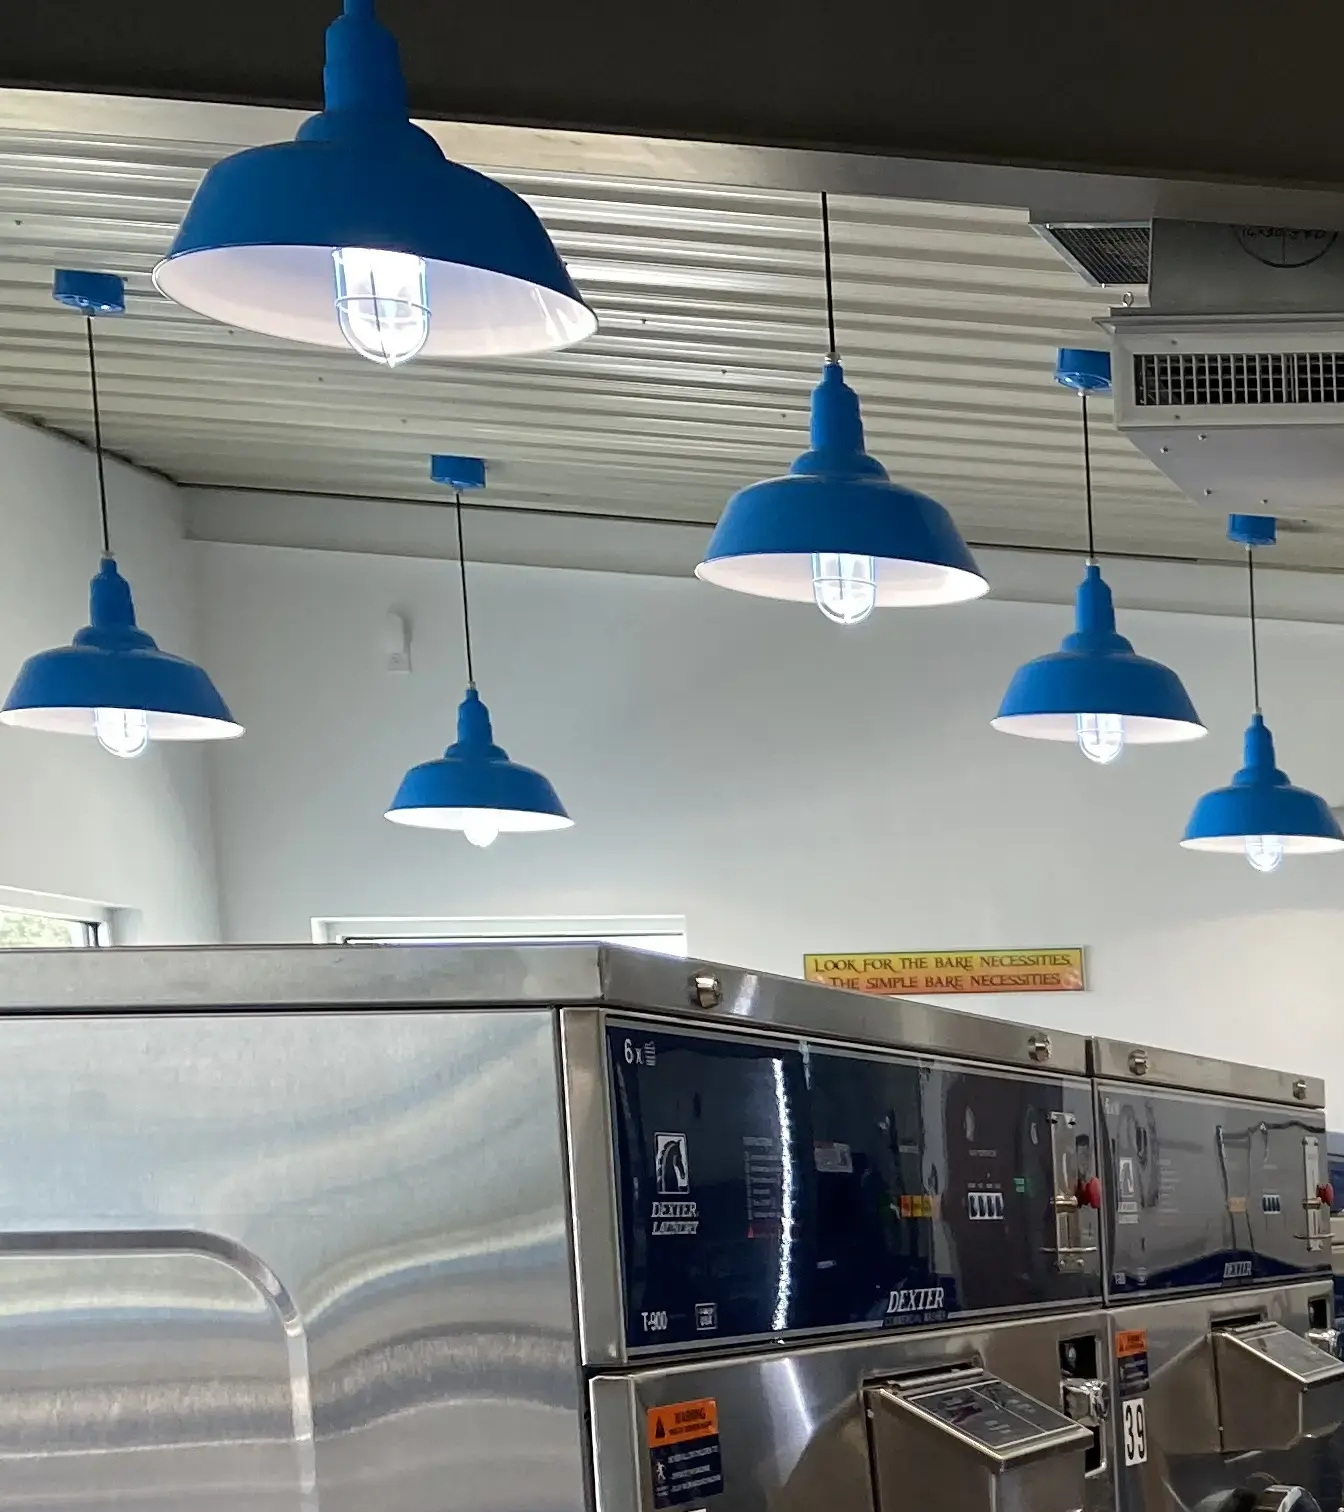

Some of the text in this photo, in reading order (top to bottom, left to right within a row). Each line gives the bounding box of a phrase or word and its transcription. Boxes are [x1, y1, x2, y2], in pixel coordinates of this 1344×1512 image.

[814, 958, 864, 973] LOOK
[861, 957, 896, 973] FOR
[899, 956, 929, 971] THE
[934, 955, 974, 971] BARE
[865, 975, 918, 989] SIMPLE
[924, 974, 964, 989] BARE
[970, 972, 1061, 987] NECESSITIES
[887, 1287, 944, 1313] DEXTER
[1126, 1404, 1147, 1462] 39
